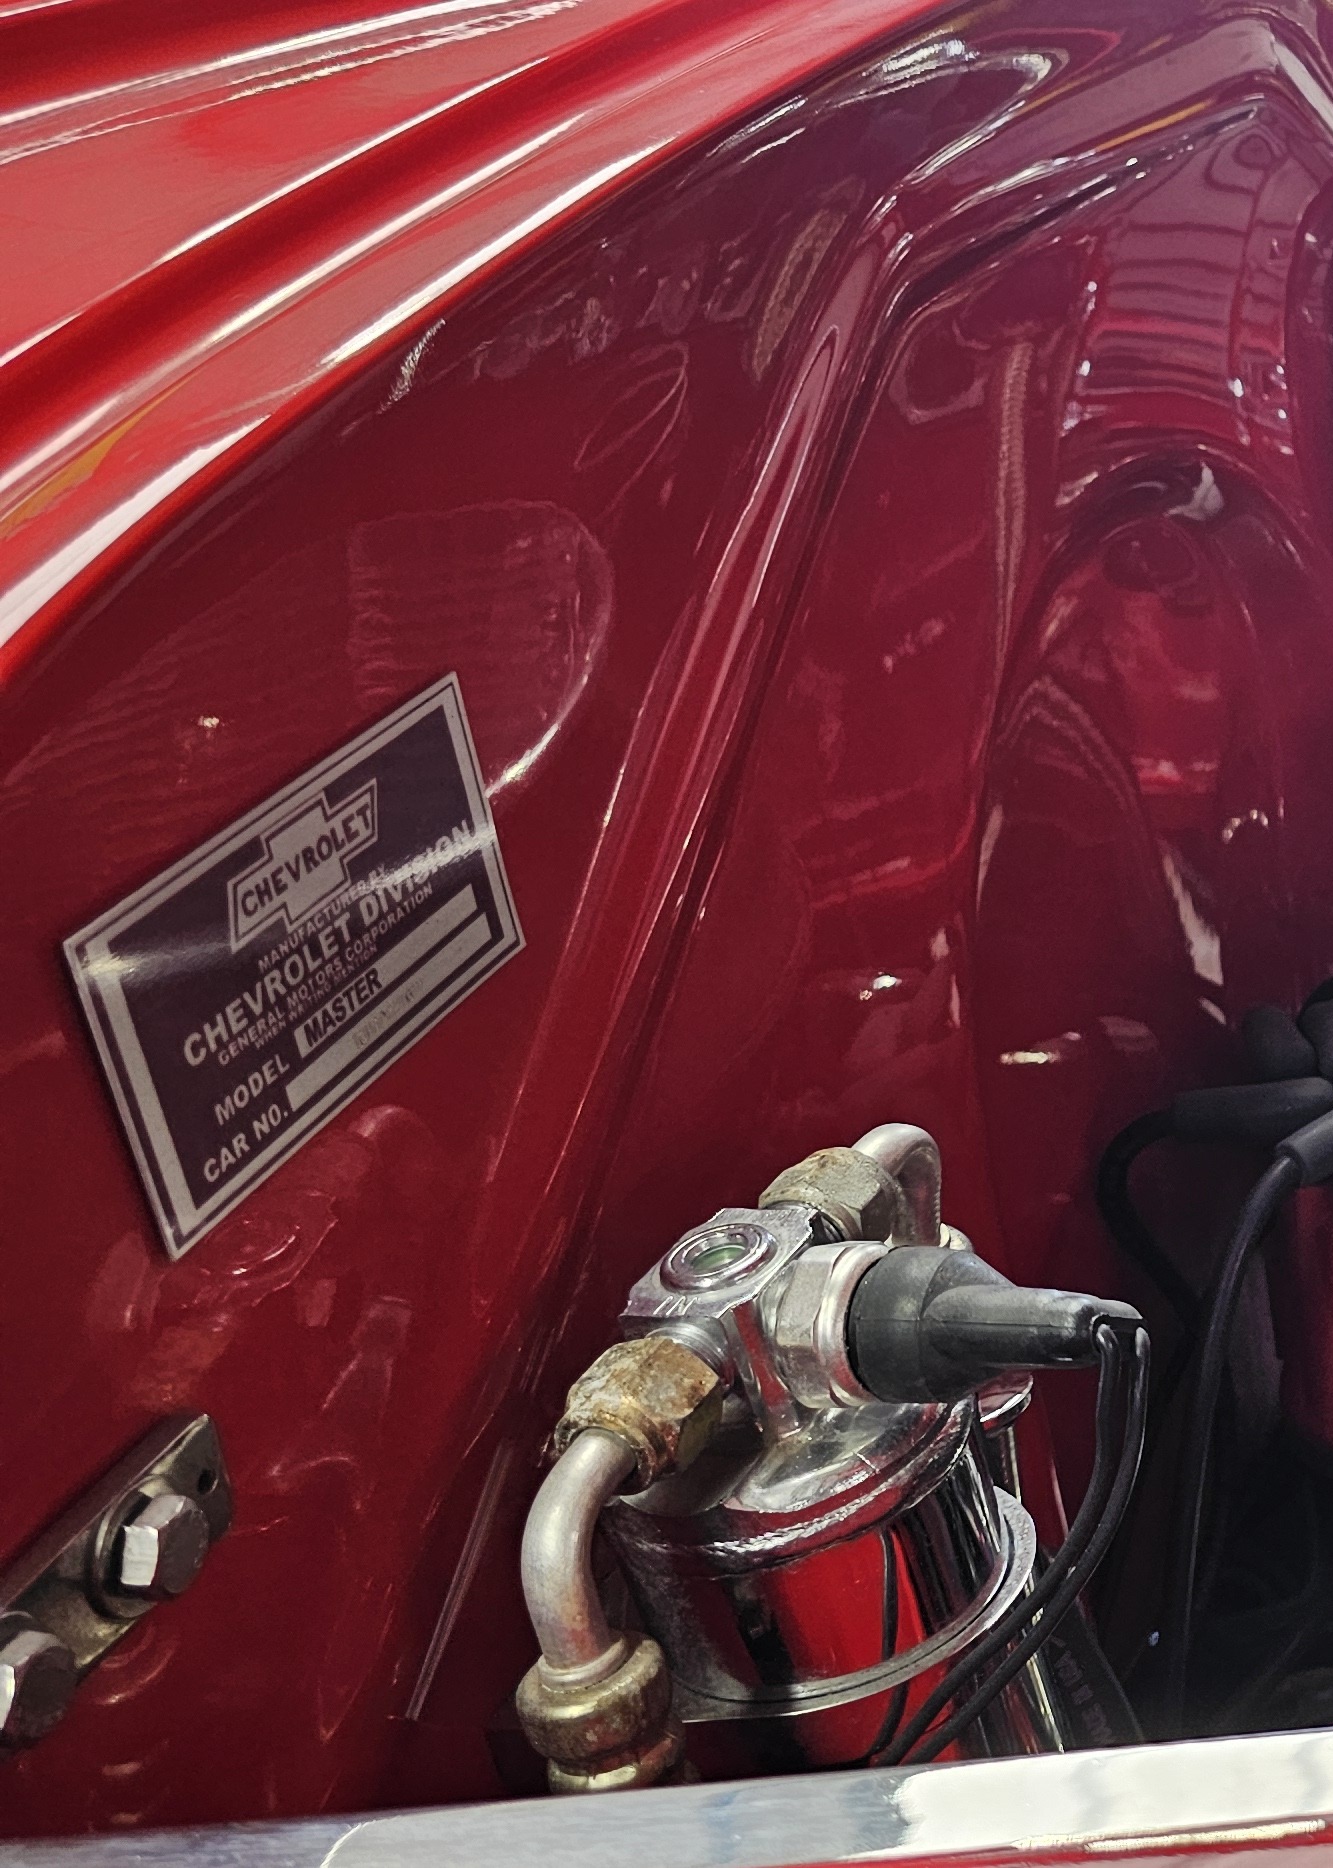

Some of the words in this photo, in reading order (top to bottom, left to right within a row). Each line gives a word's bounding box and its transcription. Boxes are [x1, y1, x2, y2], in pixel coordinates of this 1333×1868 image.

[241, 803, 372, 917] CHEVROLET
[258, 878, 366, 973] MANUFACTURED
[184, 912, 351, 1067] CHEVROLET
[218, 1005, 286, 1066] GENERAL
[286, 958, 343, 1010] MOTORS
[345, 882, 433, 962] CORPORATION
[214, 1053, 290, 1126] MODEL
[303, 967, 383, 1049] MASTER
[203, 1132, 250, 1183] CAR
[252, 1103, 288, 1141] NO.
